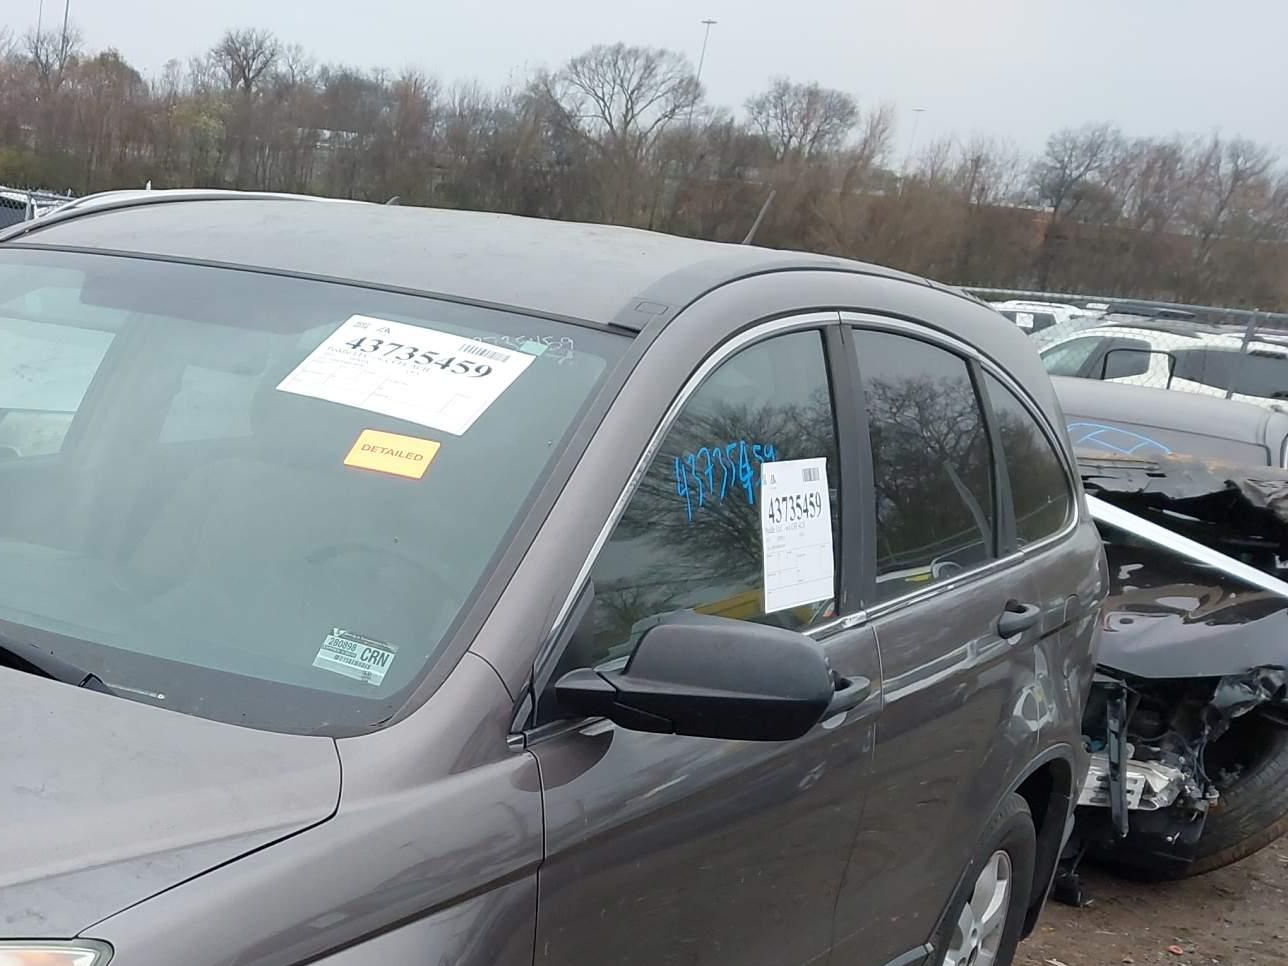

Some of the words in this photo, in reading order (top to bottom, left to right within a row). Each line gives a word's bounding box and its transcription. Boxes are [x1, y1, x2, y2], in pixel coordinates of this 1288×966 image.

[344, 336, 493, 379] 43735459
[360, 442, 425, 463] DETAILED
[768, 491, 822, 524] 43735459
[360, 647, 391, 668] CRN
